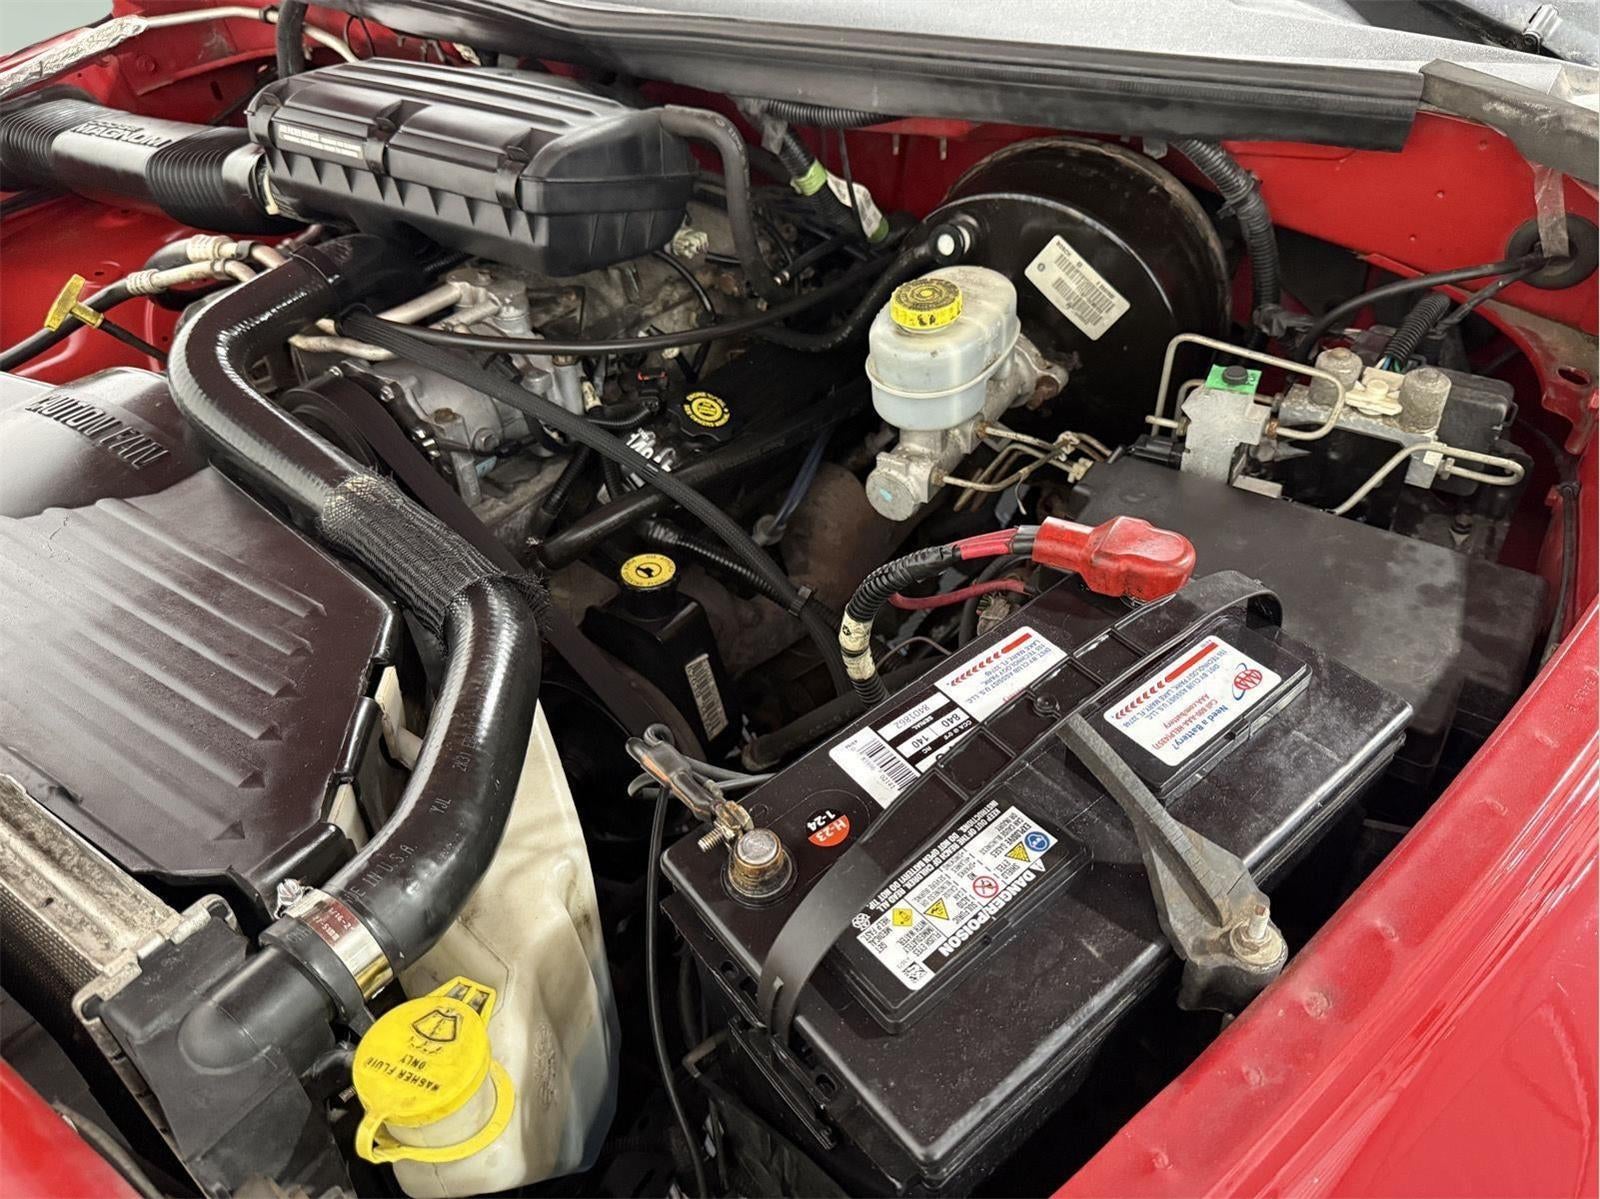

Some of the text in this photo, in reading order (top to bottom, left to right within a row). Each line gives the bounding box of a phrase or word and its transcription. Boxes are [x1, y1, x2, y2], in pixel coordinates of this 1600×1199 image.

[70, 123, 172, 148] MAGNUM
[100, 426, 168, 470] FAN
[1233, 669, 1263, 692] AAA
[892, 703, 931, 729] 8401862
[1204, 703, 1229, 721] Need
[908, 712, 962, 749] 840 140
[1167, 722, 1206, 750] Battery?
[804, 806, 836, 833] 1-24
[814, 816, 847, 845] H-23
[965, 871, 977, 880] NO
[934, 868, 1039, 956] DANGER/POISON
[866, 925, 892, 947] MEDICAL
[872, 941, 888, 954] GET
[401, 1054, 427, 1071] ONLY
[399, 1068, 440, 1092] WASHER
